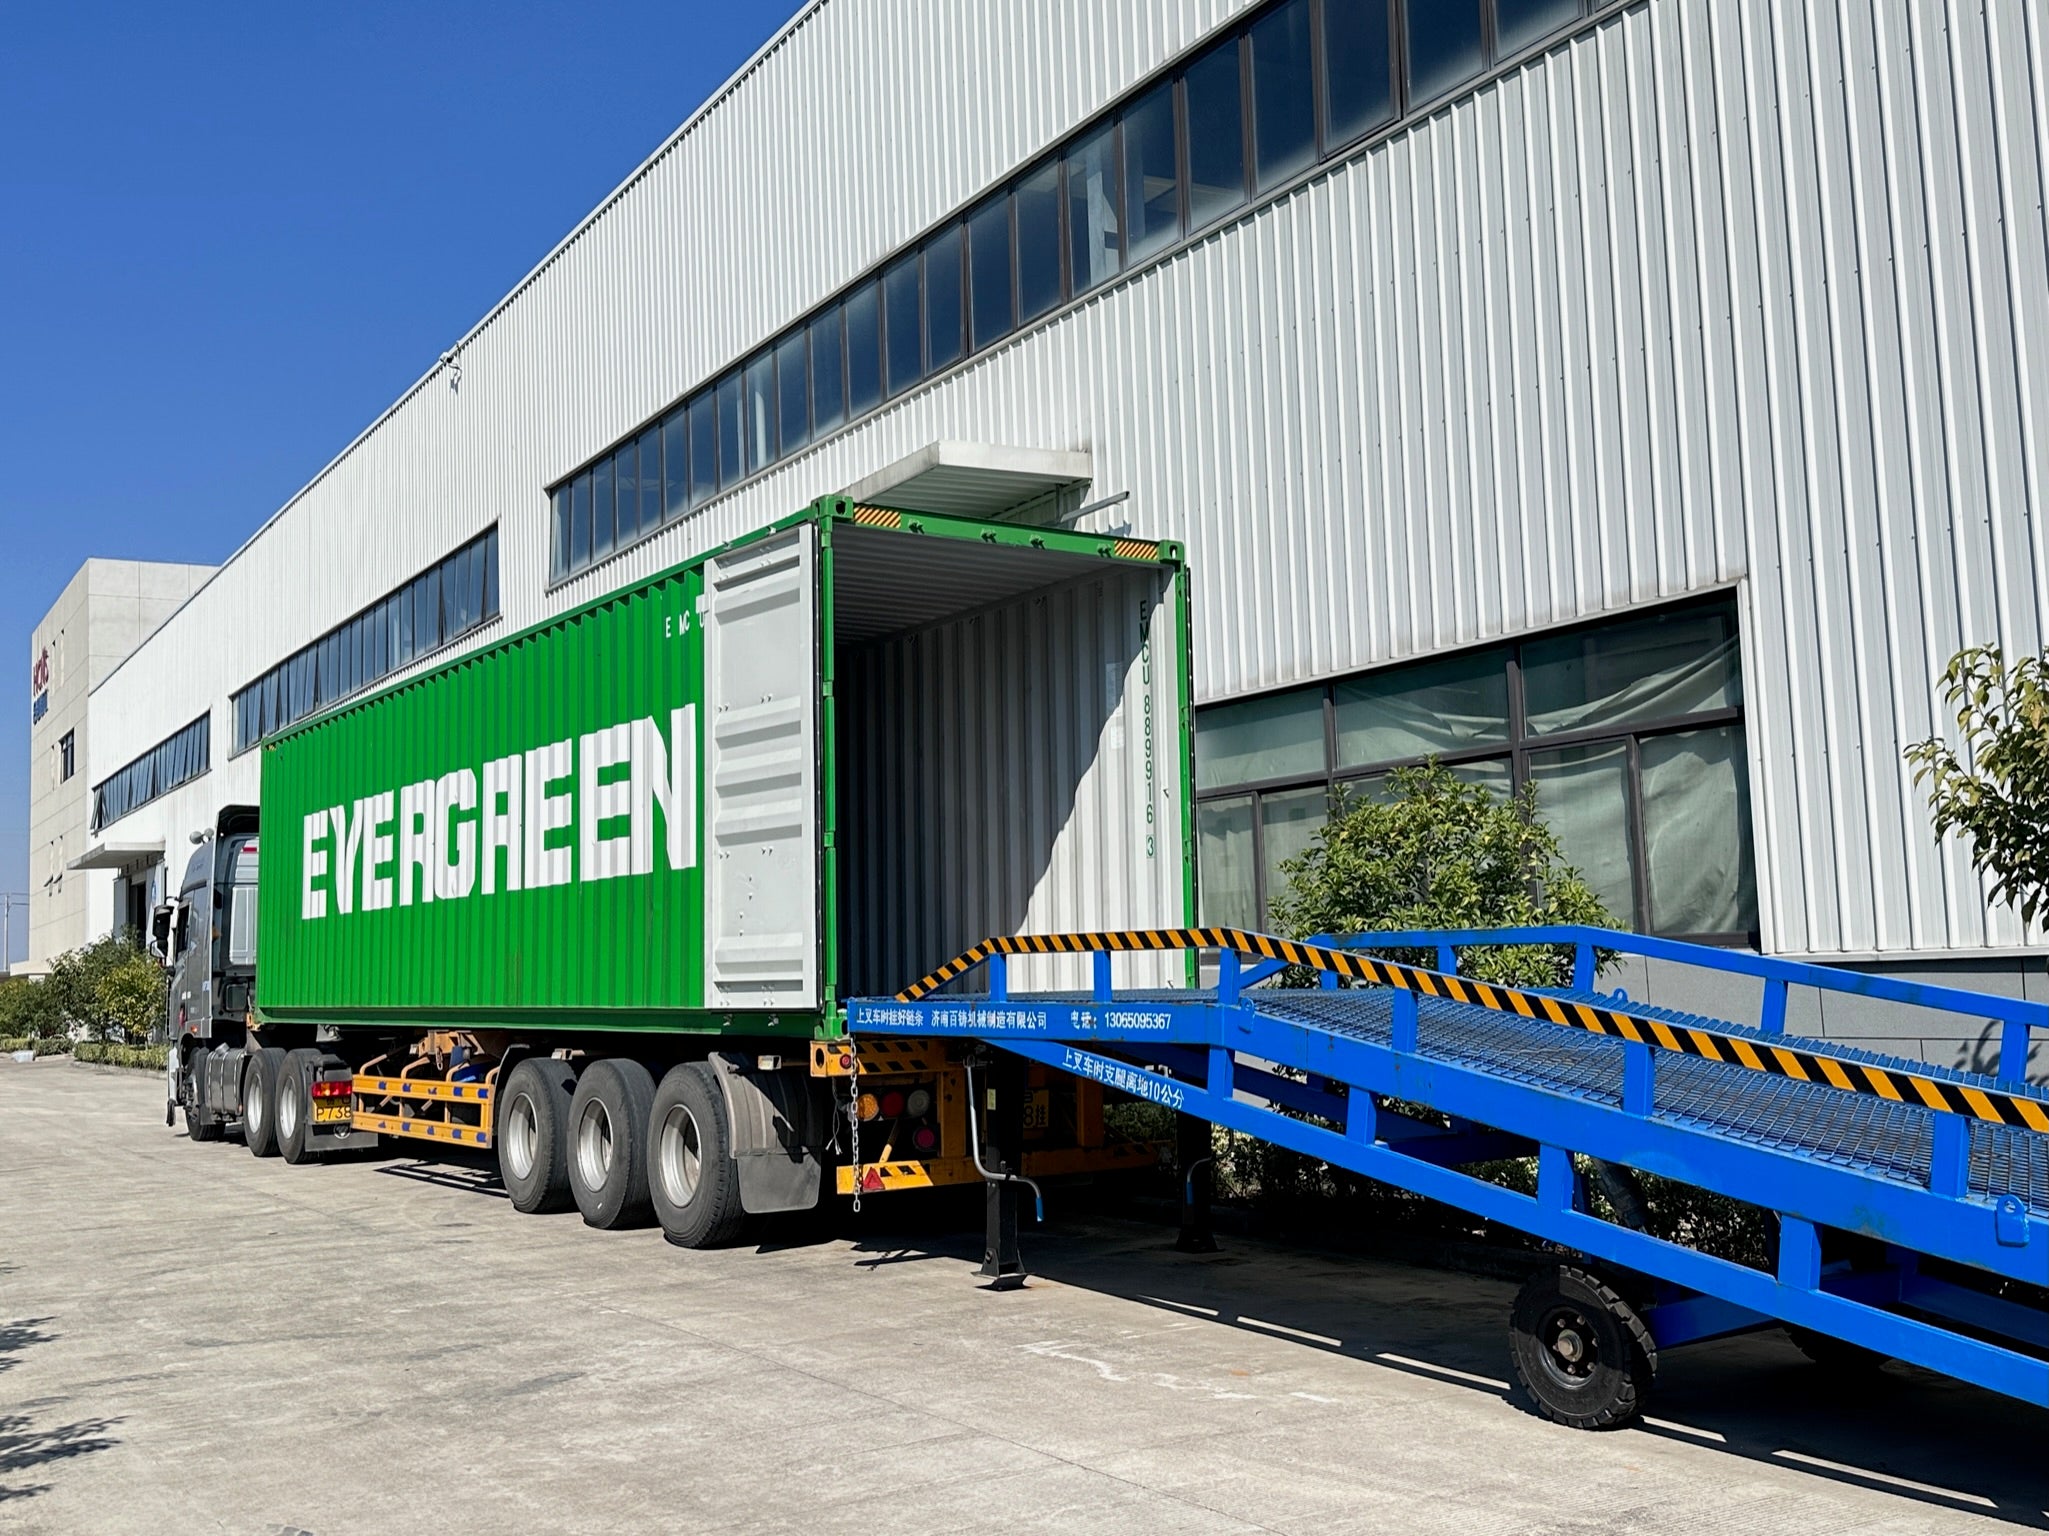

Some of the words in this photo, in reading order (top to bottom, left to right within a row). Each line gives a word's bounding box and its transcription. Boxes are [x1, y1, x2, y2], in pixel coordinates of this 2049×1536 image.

[1139, 600, 1150, 685] EMCU
[1144, 695, 1153, 824] 889916
[302, 703, 697, 919] EVERGREEN
[1146, 835, 1154, 858] 3
[856, 1008, 924, 1027] 上叉车时挂好链条
[1104, 1011, 1171, 1030] 13065095367
[1062, 1048, 1184, 1109] 上叉车时支腿离地10公分
